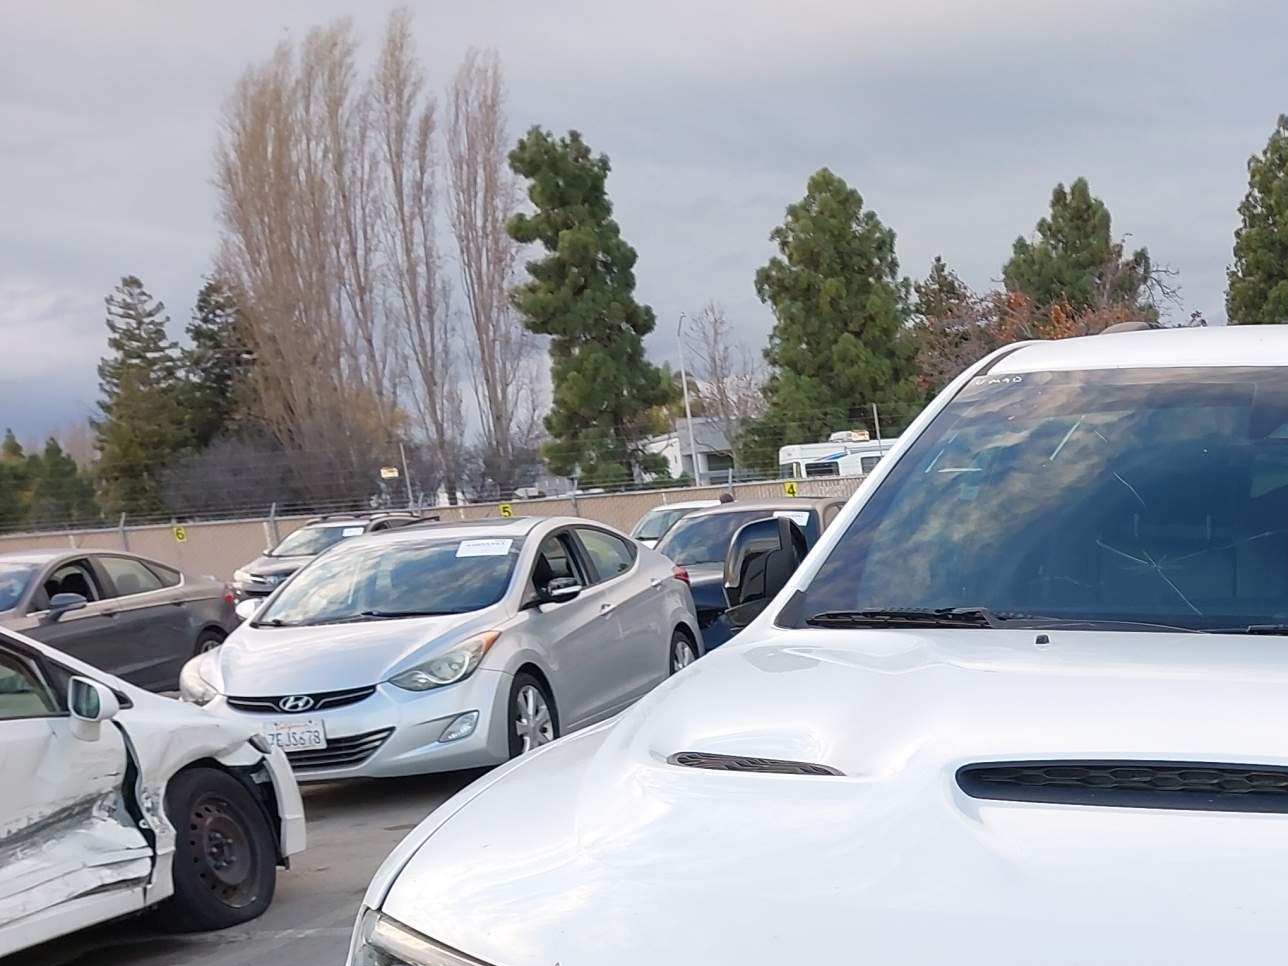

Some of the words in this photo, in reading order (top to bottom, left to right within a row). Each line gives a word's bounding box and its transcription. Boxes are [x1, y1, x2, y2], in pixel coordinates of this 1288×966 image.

[787, 484, 797, 497] 4
[502, 505, 512, 518] 5
[175, 527, 185, 541] 6
